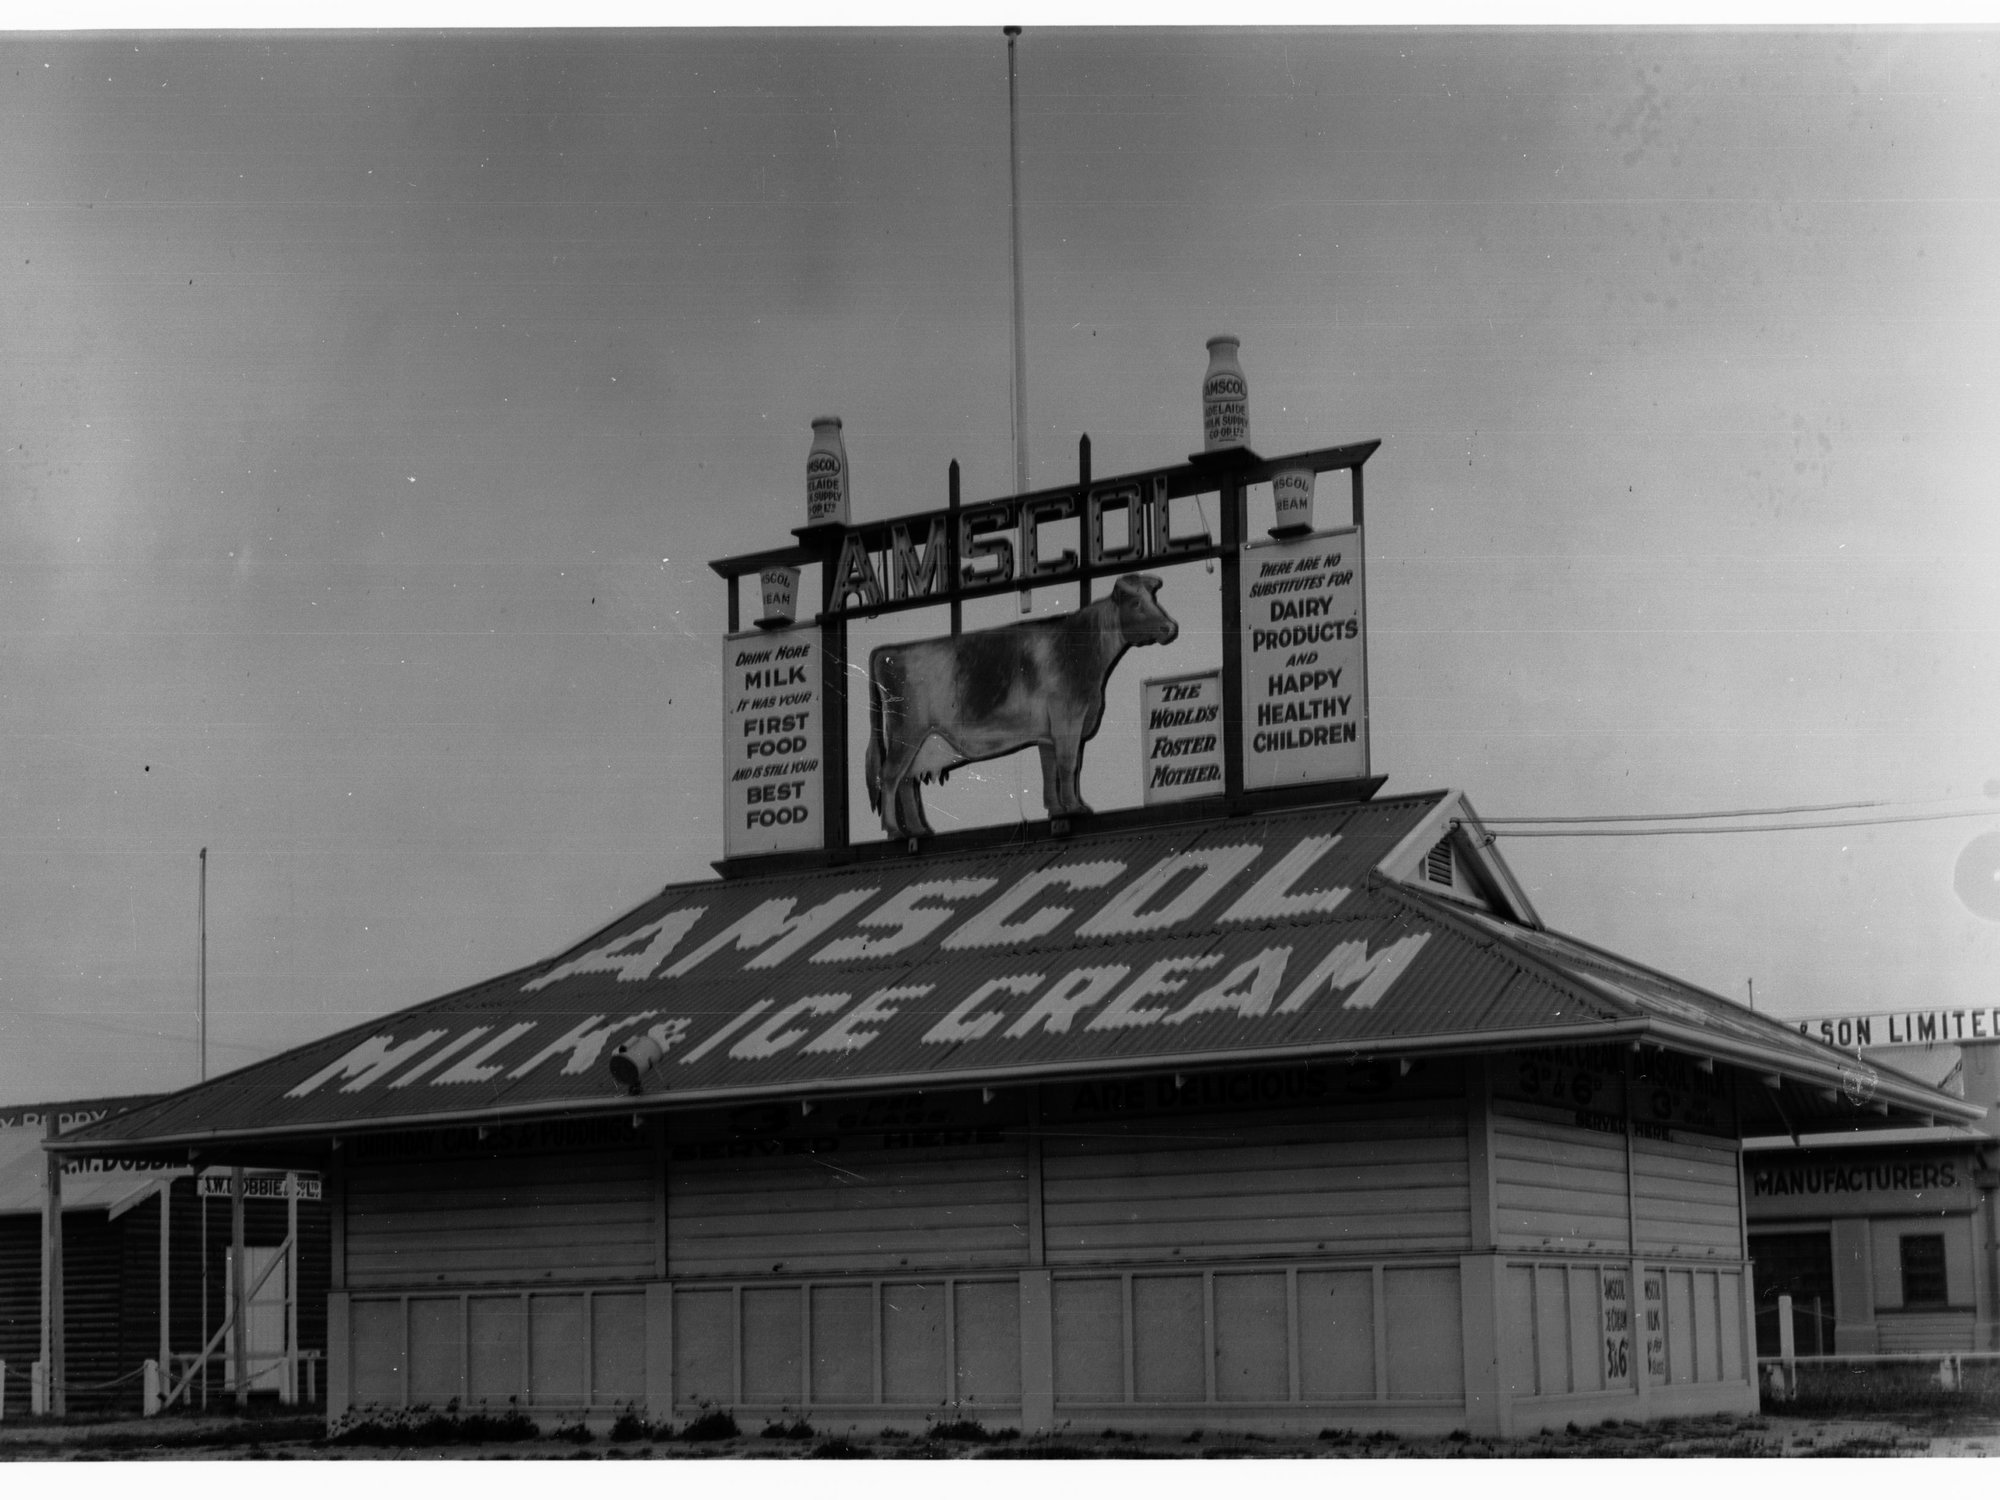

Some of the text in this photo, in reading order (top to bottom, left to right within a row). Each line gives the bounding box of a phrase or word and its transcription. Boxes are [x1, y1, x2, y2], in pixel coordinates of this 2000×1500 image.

[827, 476, 1212, 613] AMSCOL
[1259, 552, 1342, 578] THERE ARE NO
[1249, 569, 1354, 598] SUBSTITUTES FOR
[1270, 594, 1334, 622] DAIRY
[1252, 618, 1359, 653] PRODUCTS
[735, 643, 811, 667] DRINK MORE
[1285, 650, 1319, 668] AND
[745, 665, 807, 691] MILK
[1268, 666, 1343, 697] HAPPY
[736, 690, 813, 712] IT WAS YOUR
[1161, 682, 1202, 703] THE
[743, 711, 809, 737] FIRST
[1149, 703, 1219, 730] WORLD'S
[1257, 694, 1352, 727] HEALTHY
[746, 735, 807, 760] FOOD
[1150, 733, 1218, 760] FOSTER
[1252, 720, 1357, 754] CHILDREN
[731, 758, 819, 782] AND IS STILL YOUR
[746, 780, 806, 805] BEST
[746, 805, 809, 830] FOOD
[519, 834, 1351, 992] AMSCOL
[283, 1010, 660, 1099] MILK
[678, 984, 937, 1066] ICE
[920, 931, 1432, 1046] CREAM
[1820, 1017, 1872, 1047] SON
[1071, 1068, 1327, 1115] ARE DELICIOUS
